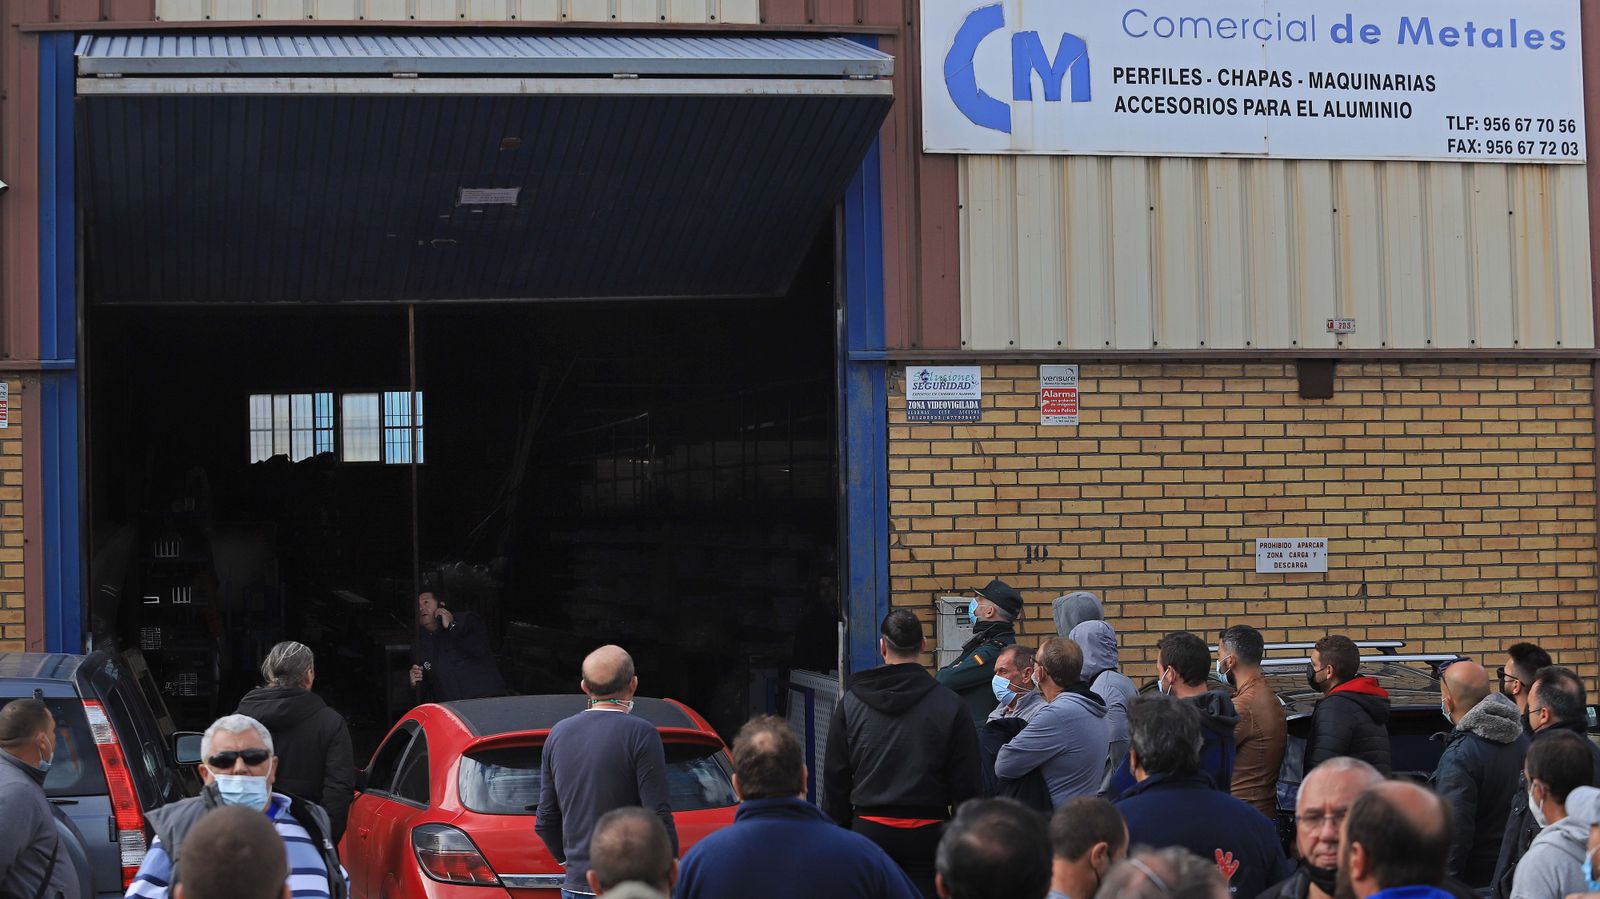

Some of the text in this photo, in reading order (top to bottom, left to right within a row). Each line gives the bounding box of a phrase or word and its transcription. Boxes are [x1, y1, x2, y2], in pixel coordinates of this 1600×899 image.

[1122, 8, 1567, 51] Comercial de Metales
[1112, 66, 1203, 87] PERFILES
[1217, 68, 1293, 89] CHAPAS
[1308, 71, 1436, 93] MAQUINARIAS
[1114, 95, 1413, 120] ACCESORIOS PARA EL ALUMINIO
[1445, 115, 1576, 134] TLF: 956 67 70 56
[1447, 138, 1579, 157] FAX: 956 67 72 03
[912, 381, 972, 391] SEGURIDAD
[1043, 390, 1076, 398] Alarma
[908, 400, 979, 410] ZONA VIDEOVIGILADA
